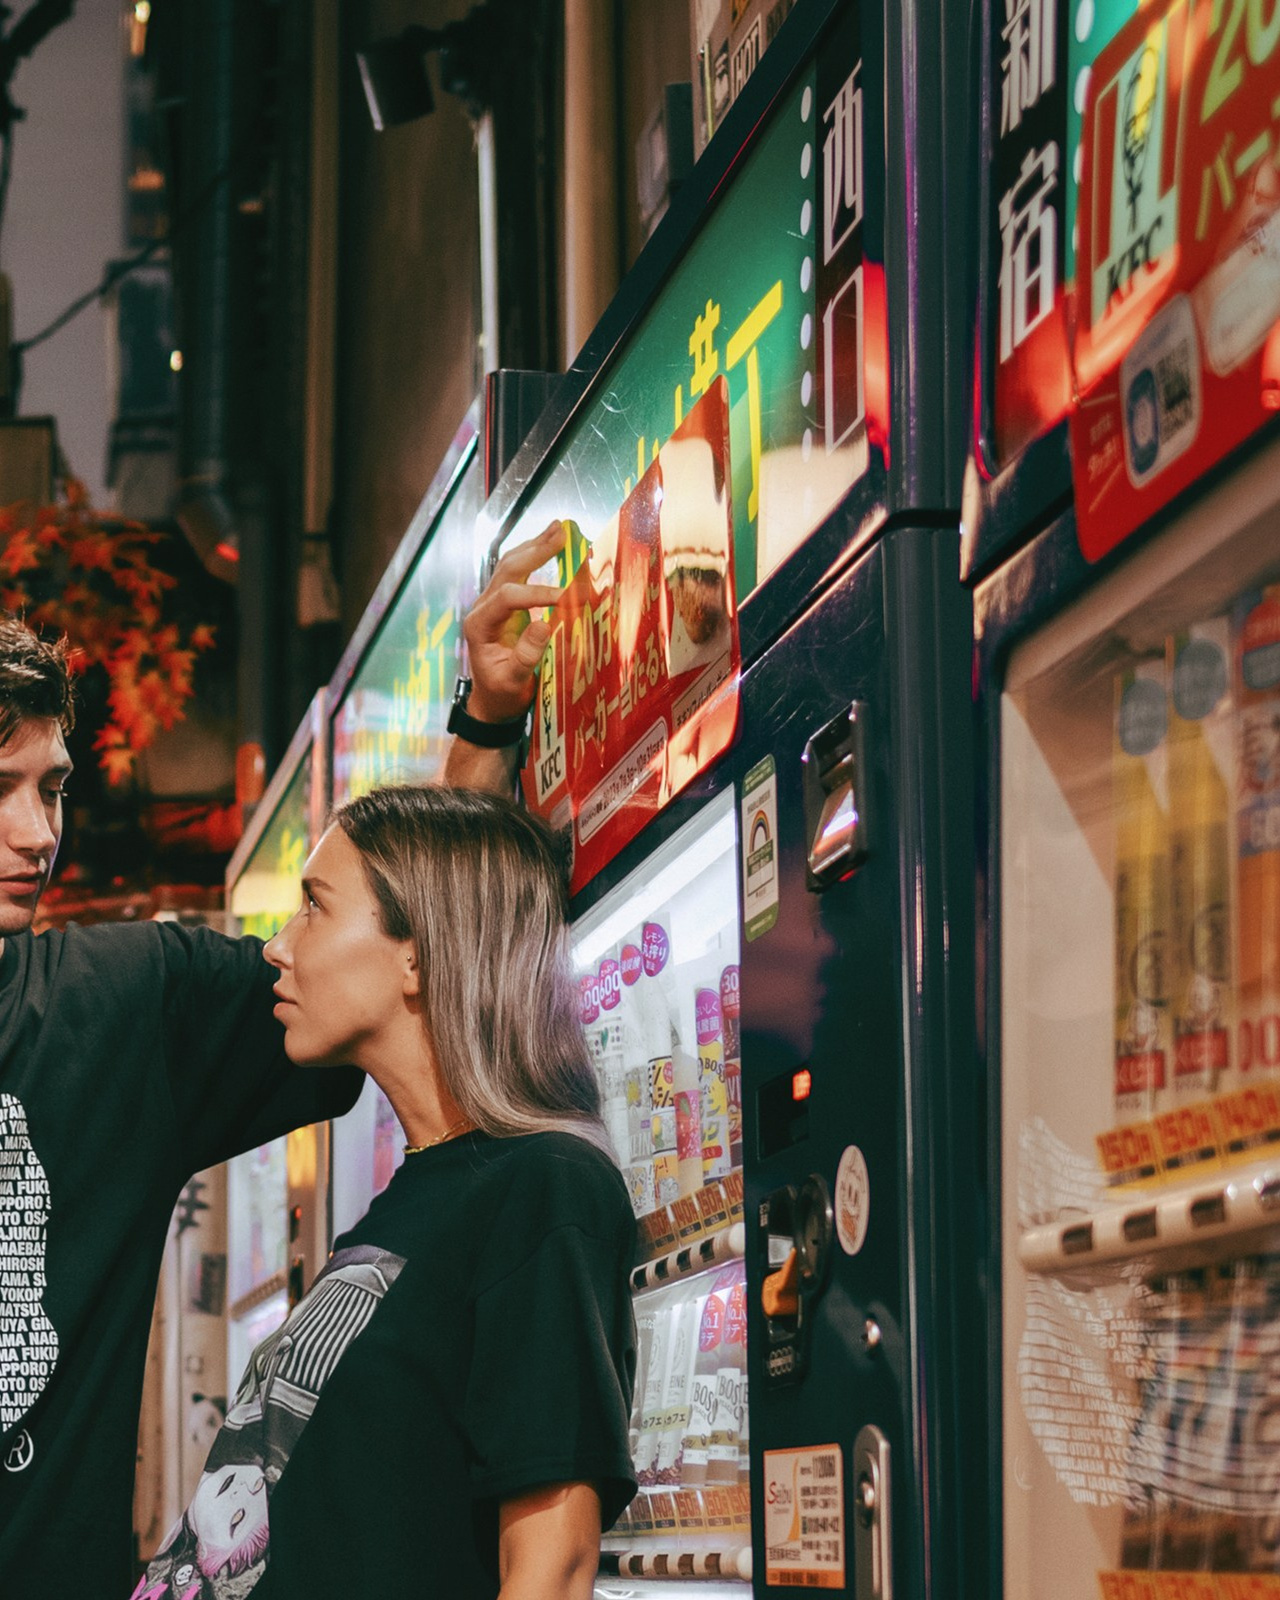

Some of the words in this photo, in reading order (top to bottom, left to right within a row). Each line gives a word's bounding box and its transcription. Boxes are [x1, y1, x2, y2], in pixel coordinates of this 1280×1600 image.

[822, 56, 865, 456] 西口
[997, 0, 1058, 366] 新宿
[539, 746, 562, 797] KFC
